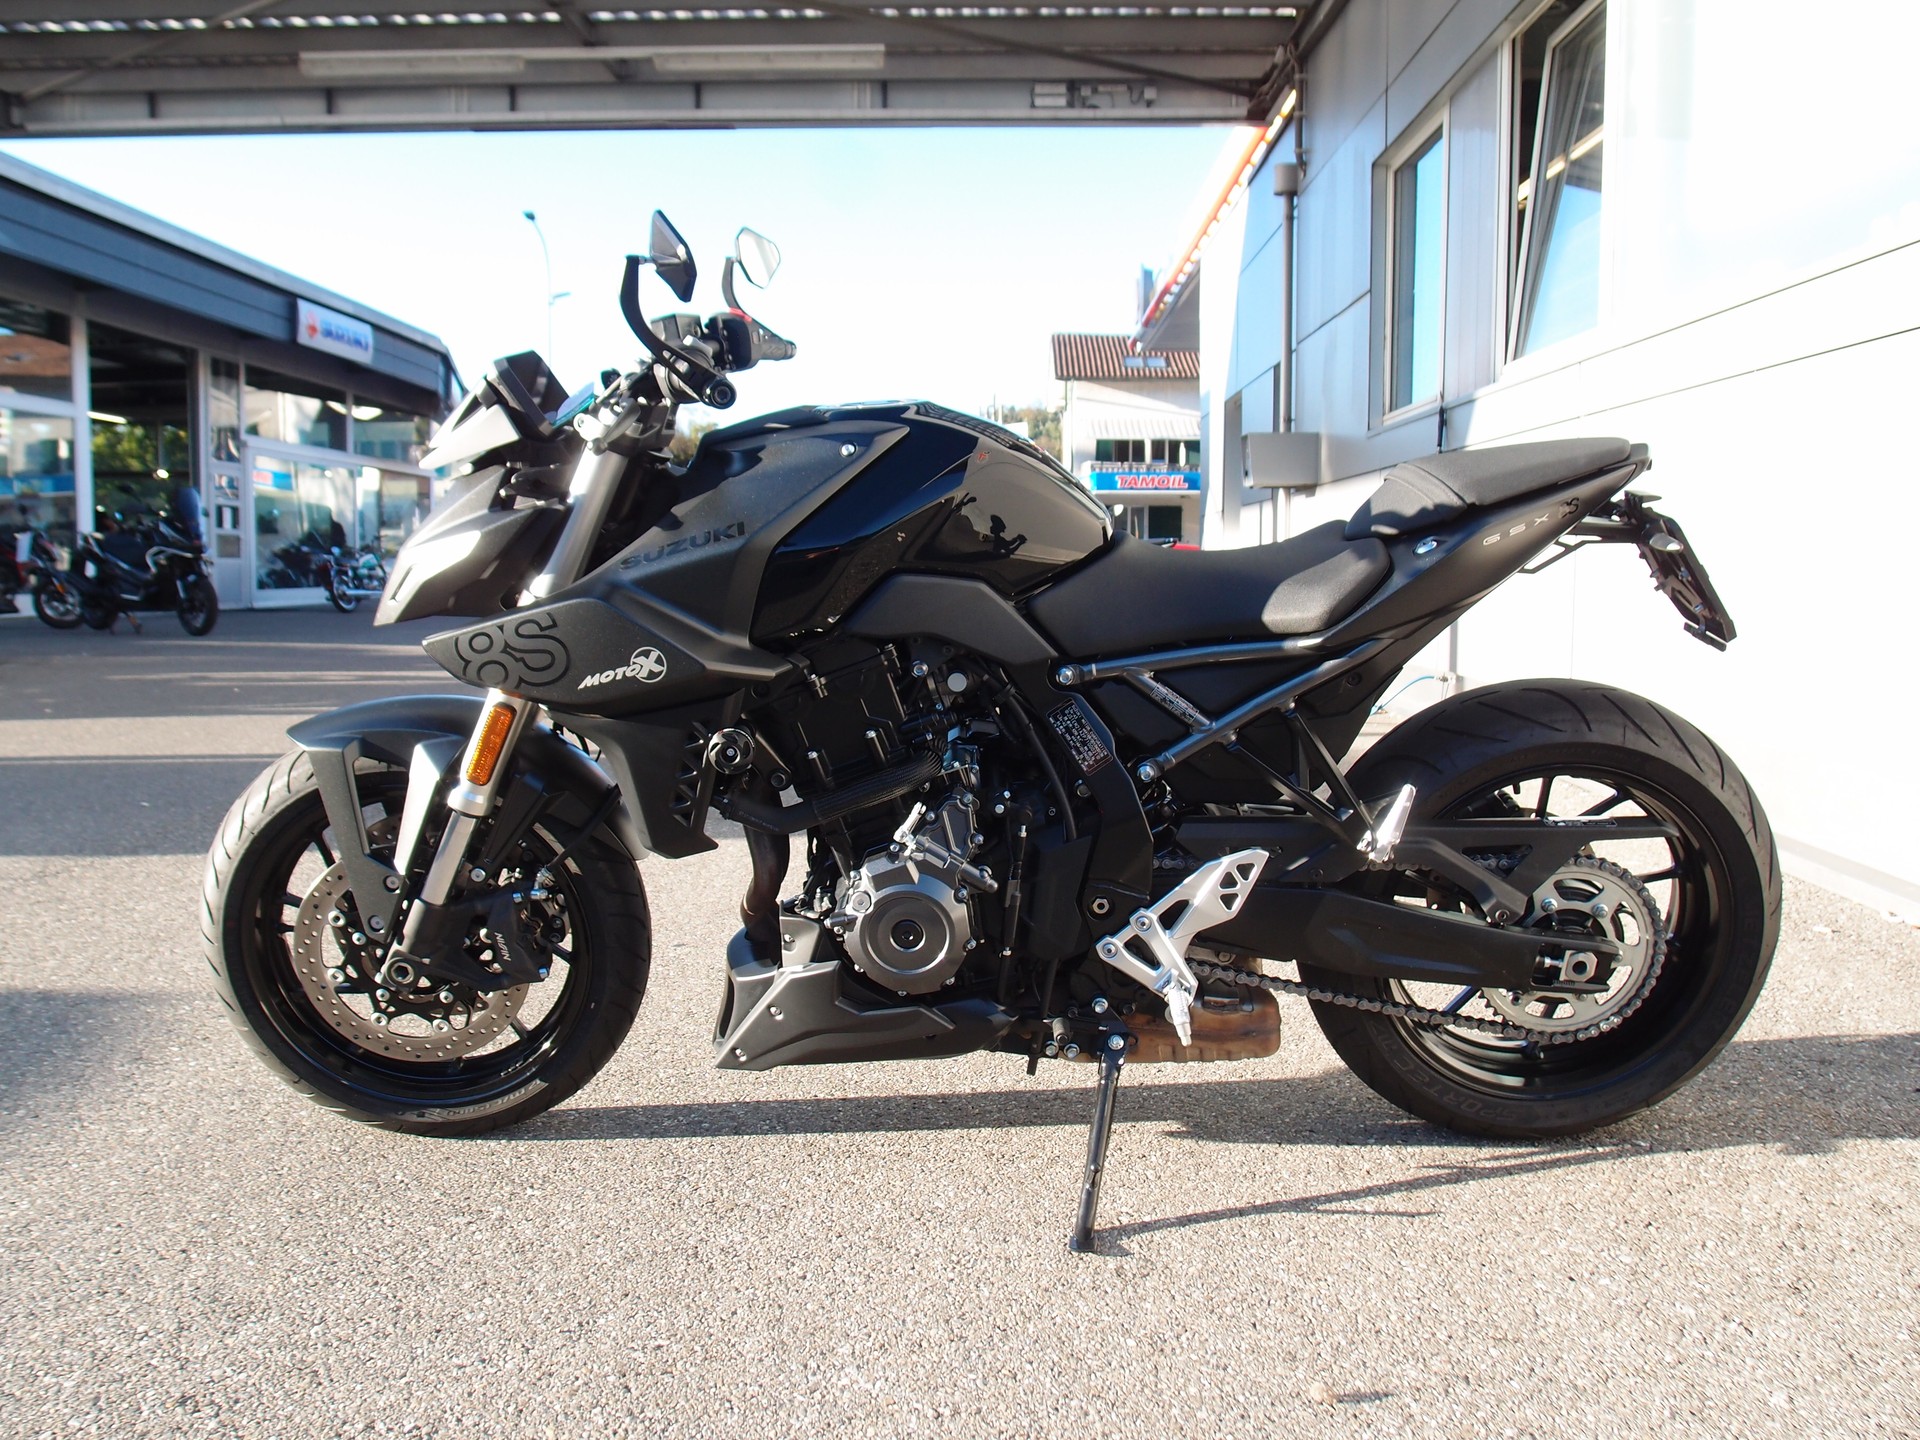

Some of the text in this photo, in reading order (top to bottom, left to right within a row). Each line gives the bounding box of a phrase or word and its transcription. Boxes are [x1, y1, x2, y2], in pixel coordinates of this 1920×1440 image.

[1115, 474, 1188, 490] TAMOIL
[619, 521, 746, 571] SUZUKI
[1483, 513, 1549, 545] GSX
[454, 612, 571, 690] 8S
